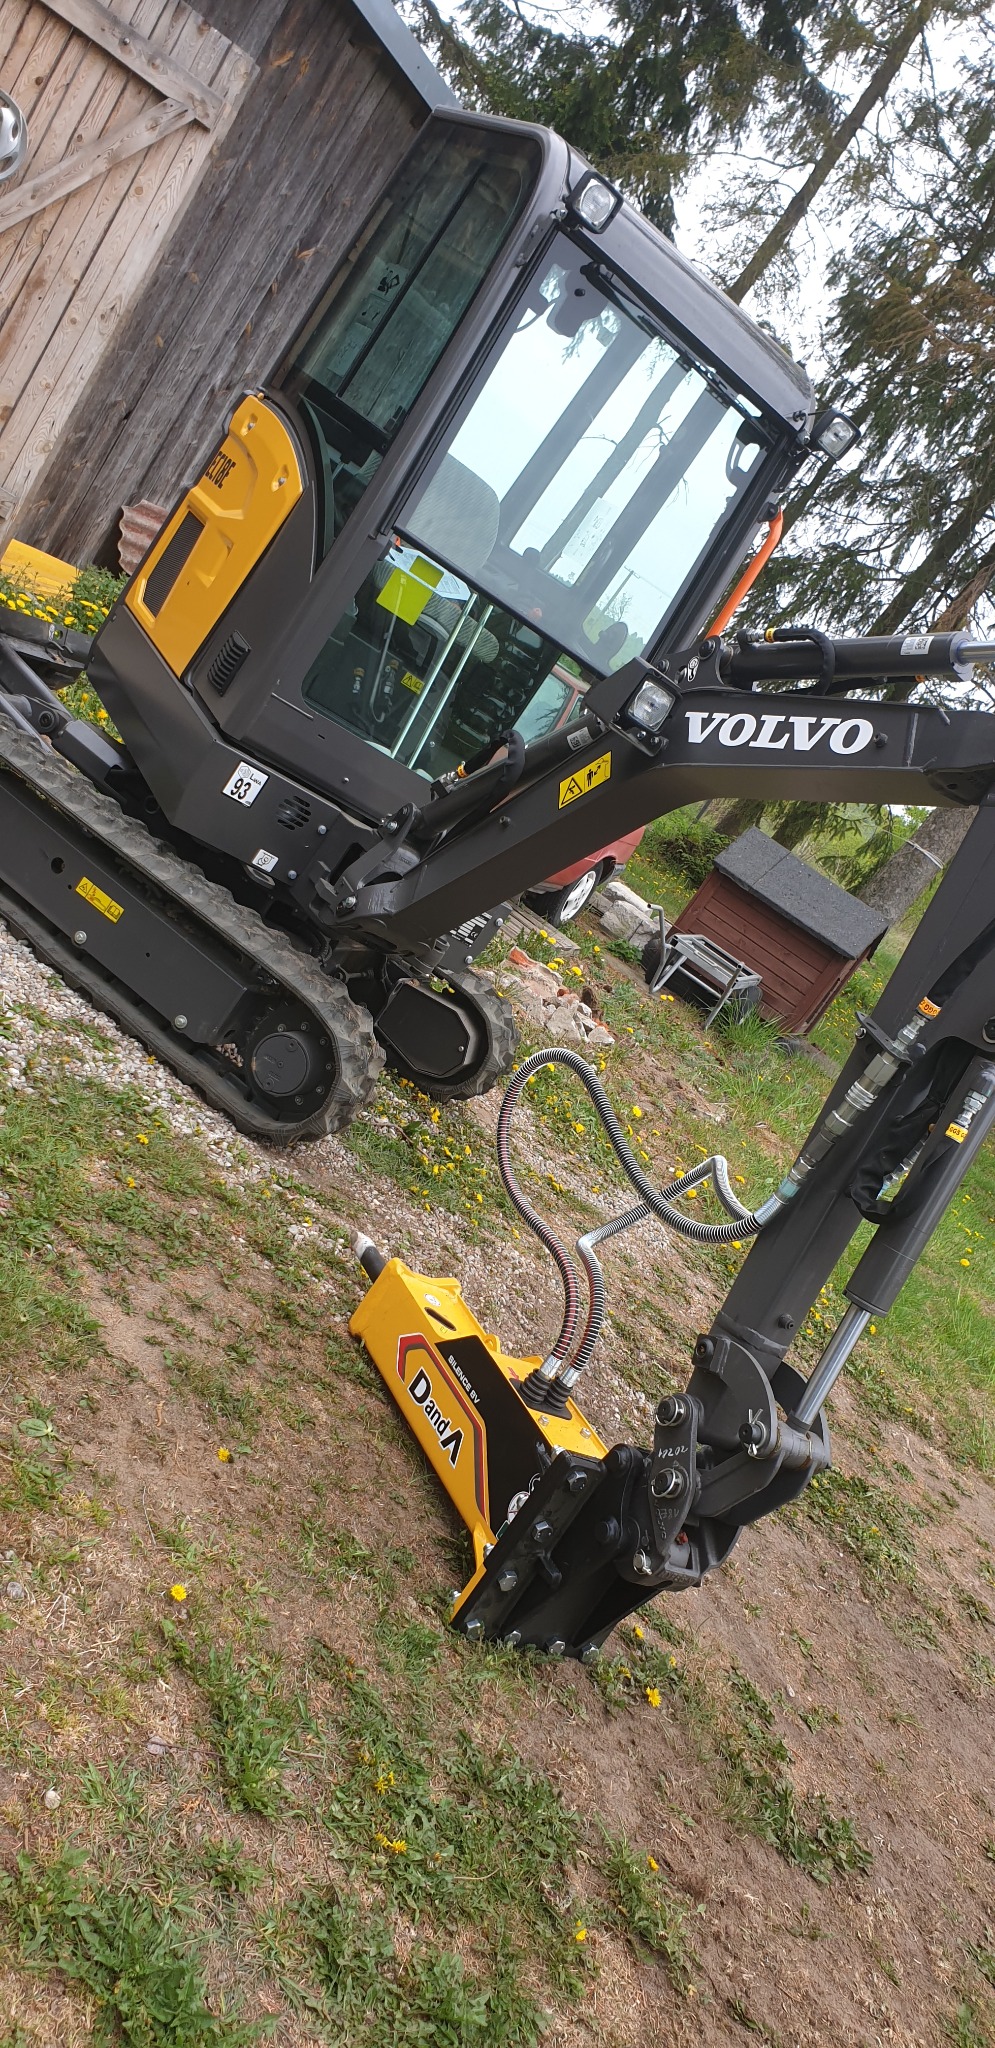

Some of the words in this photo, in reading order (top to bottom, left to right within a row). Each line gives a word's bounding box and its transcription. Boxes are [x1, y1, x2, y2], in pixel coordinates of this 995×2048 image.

[684, 711, 874, 755] VOLVO
[230, 778, 252, 800] 93
[447, 1354, 472, 1393] SILENCE
